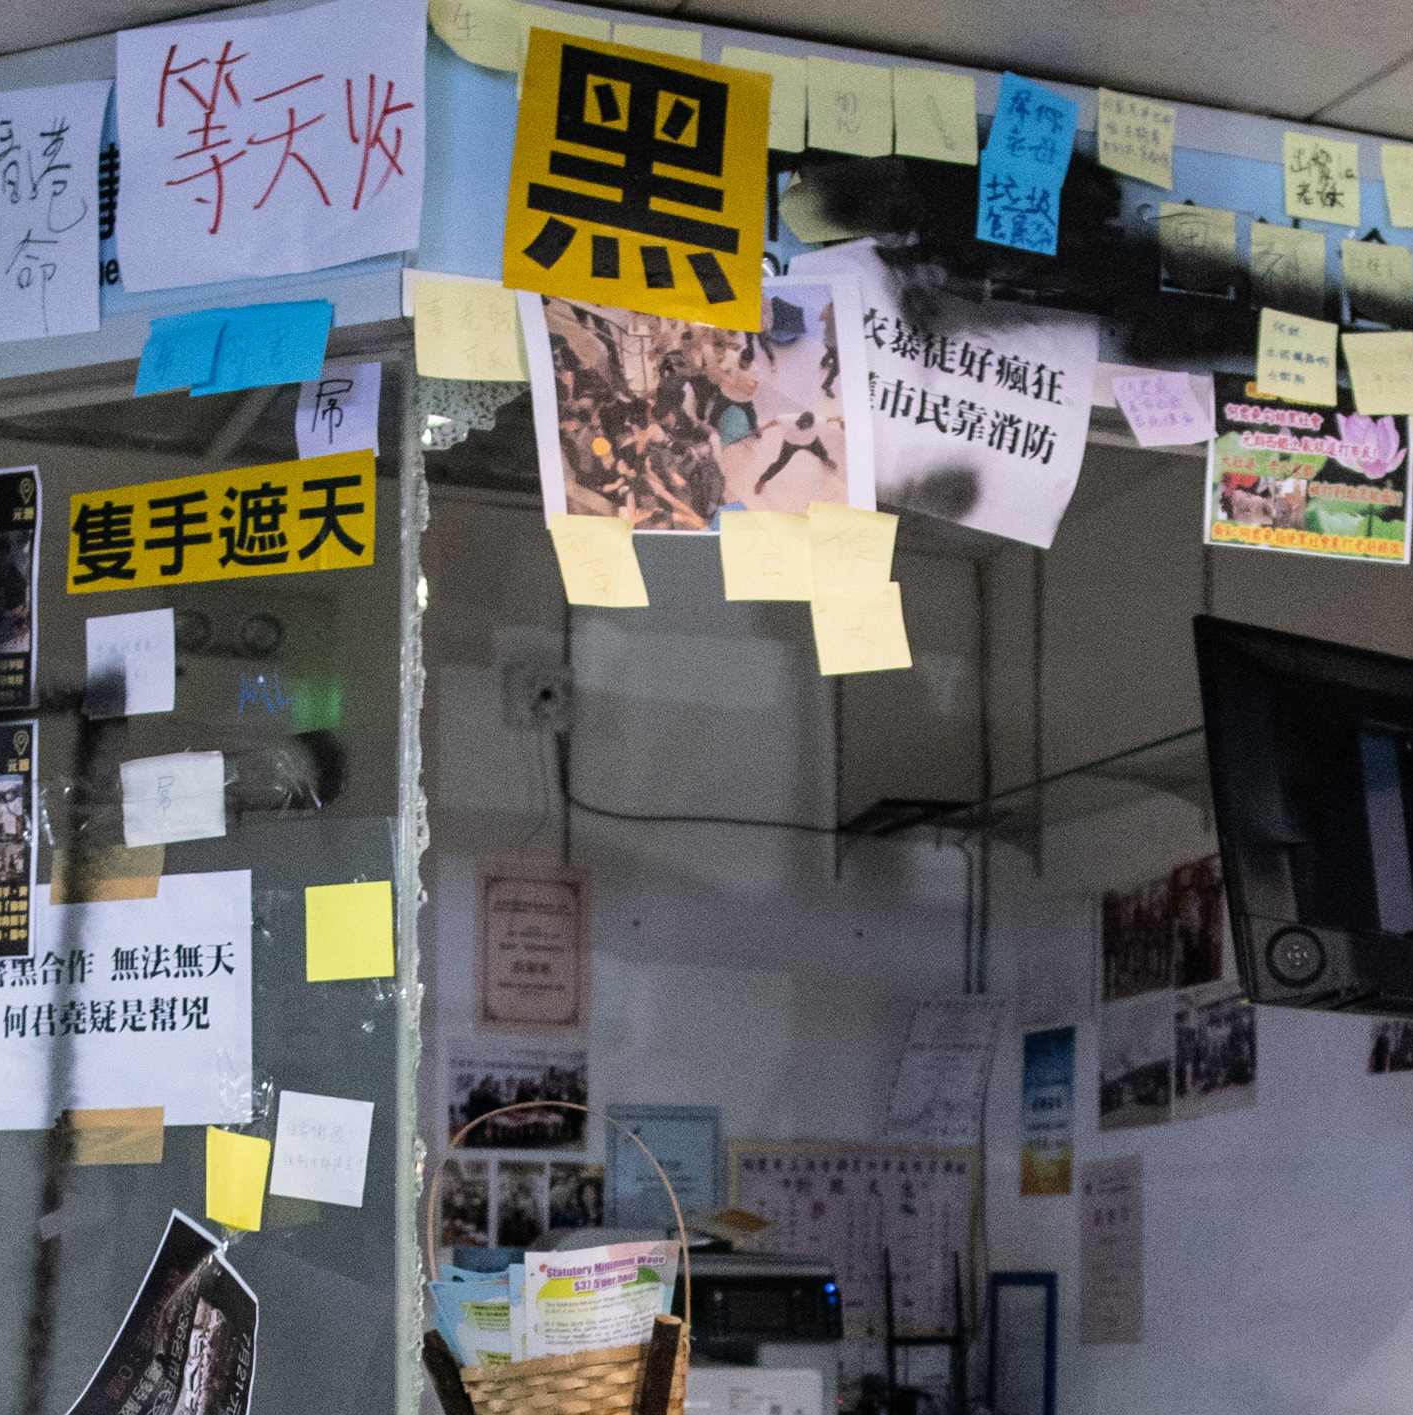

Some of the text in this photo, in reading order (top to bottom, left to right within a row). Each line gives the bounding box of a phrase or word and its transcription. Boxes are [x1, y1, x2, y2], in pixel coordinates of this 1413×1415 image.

[156, 40, 414, 235] 等天收
[524, 45, 739, 304] 黑
[868, 371, 1057, 464] 市民靠消防
[72, 473, 367, 586] 隻手遮天
[111, 943, 235, 982] 無法無天
[547, 1265, 592, 1278] Statutory
